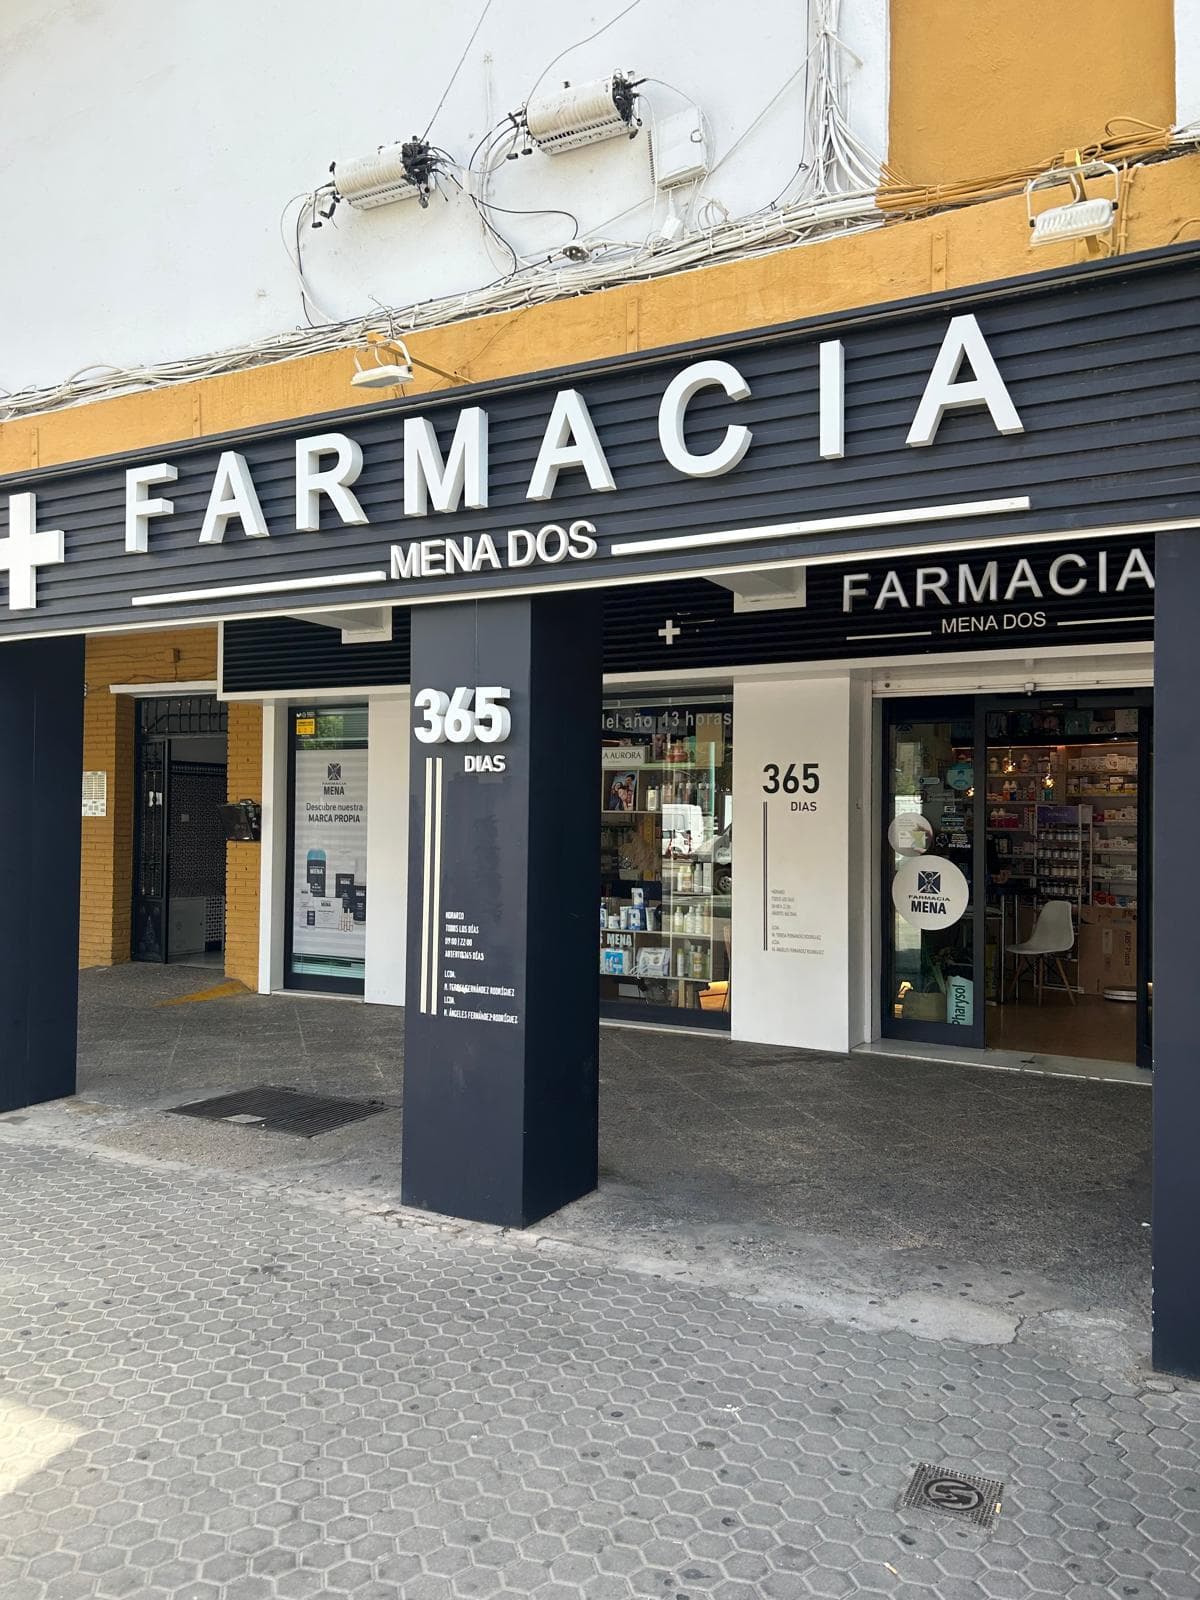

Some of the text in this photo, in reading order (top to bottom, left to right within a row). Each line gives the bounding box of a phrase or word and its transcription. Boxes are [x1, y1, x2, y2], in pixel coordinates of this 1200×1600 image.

[124, 313, 1025, 554] FARMACIA
[390, 520, 598, 580] MENA DOS
[842, 548, 1155, 612] FARMACIA
[941, 611, 1047, 634] MENA DOS
[414, 686, 512, 744] 365
[624, 712, 653, 728] año
[661, 711, 680, 727] 13
[685, 710, 732, 728] horas
[611, 750, 641, 760] AURORA
[464, 754, 507, 773] DIAS
[762, 763, 820, 794] 365
[324, 786, 345, 796] MENA
[306, 802, 364, 812] Descubre nuestra
[790, 801, 817, 812] DIAS
[308, 813, 361, 823] MARCA PROPIA
[908, 894, 951, 902] FARMACIA
[911, 901, 946, 914] MENA
[606, 933, 632, 946] MENA
